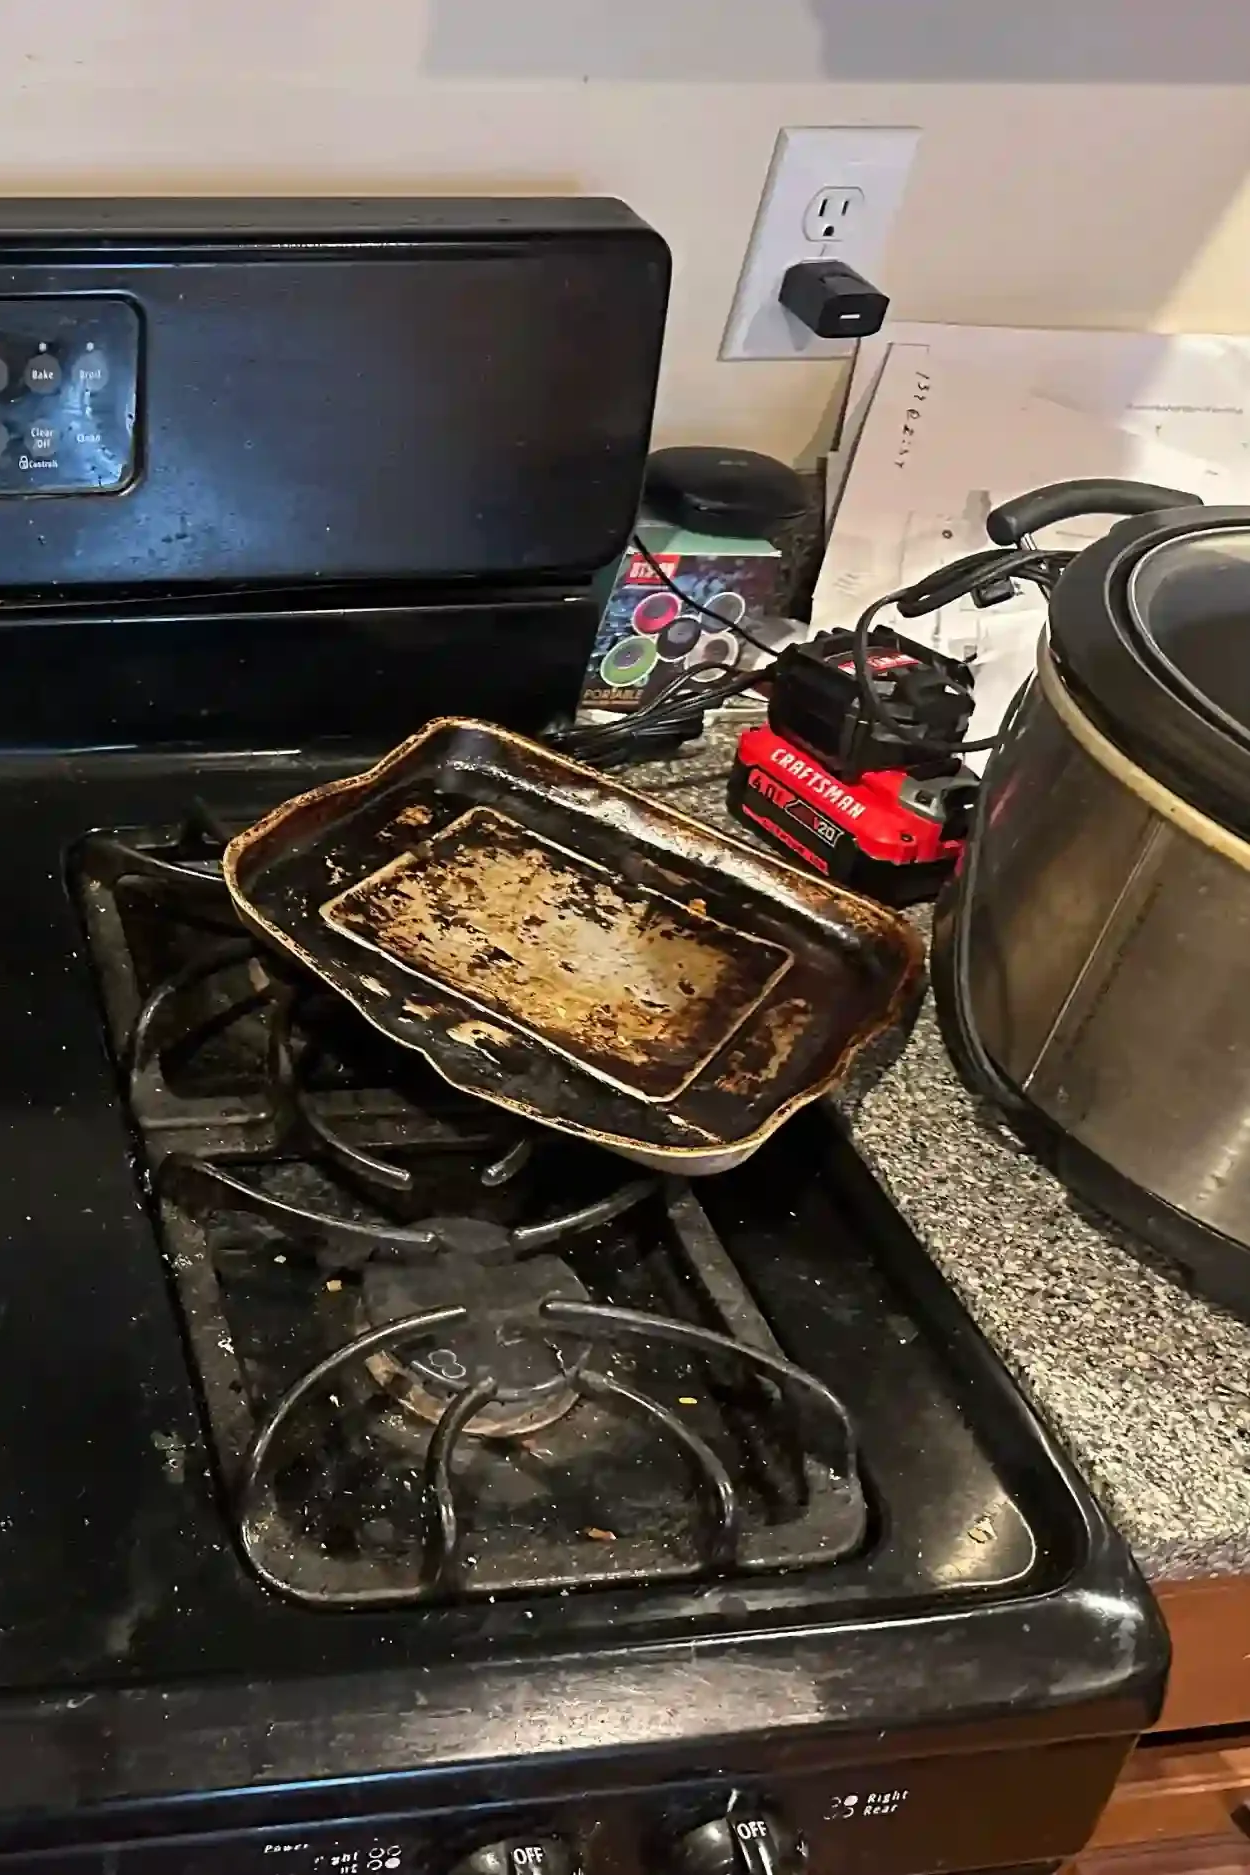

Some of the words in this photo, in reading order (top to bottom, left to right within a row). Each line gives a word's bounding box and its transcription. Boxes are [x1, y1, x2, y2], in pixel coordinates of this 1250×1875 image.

[31, 368, 54, 381] Bake
[78, 369, 101, 380] Broil
[30, 426, 54, 438] Clear
[770, 748, 867, 819] CRAFTSMAN
[867, 1790, 909, 1803] Right
[863, 1804, 898, 1816] Rear
[737, 1821, 767, 1840] OFF
[264, 1843, 309, 1853] Power
[513, 1846, 543, 1865] OFF
